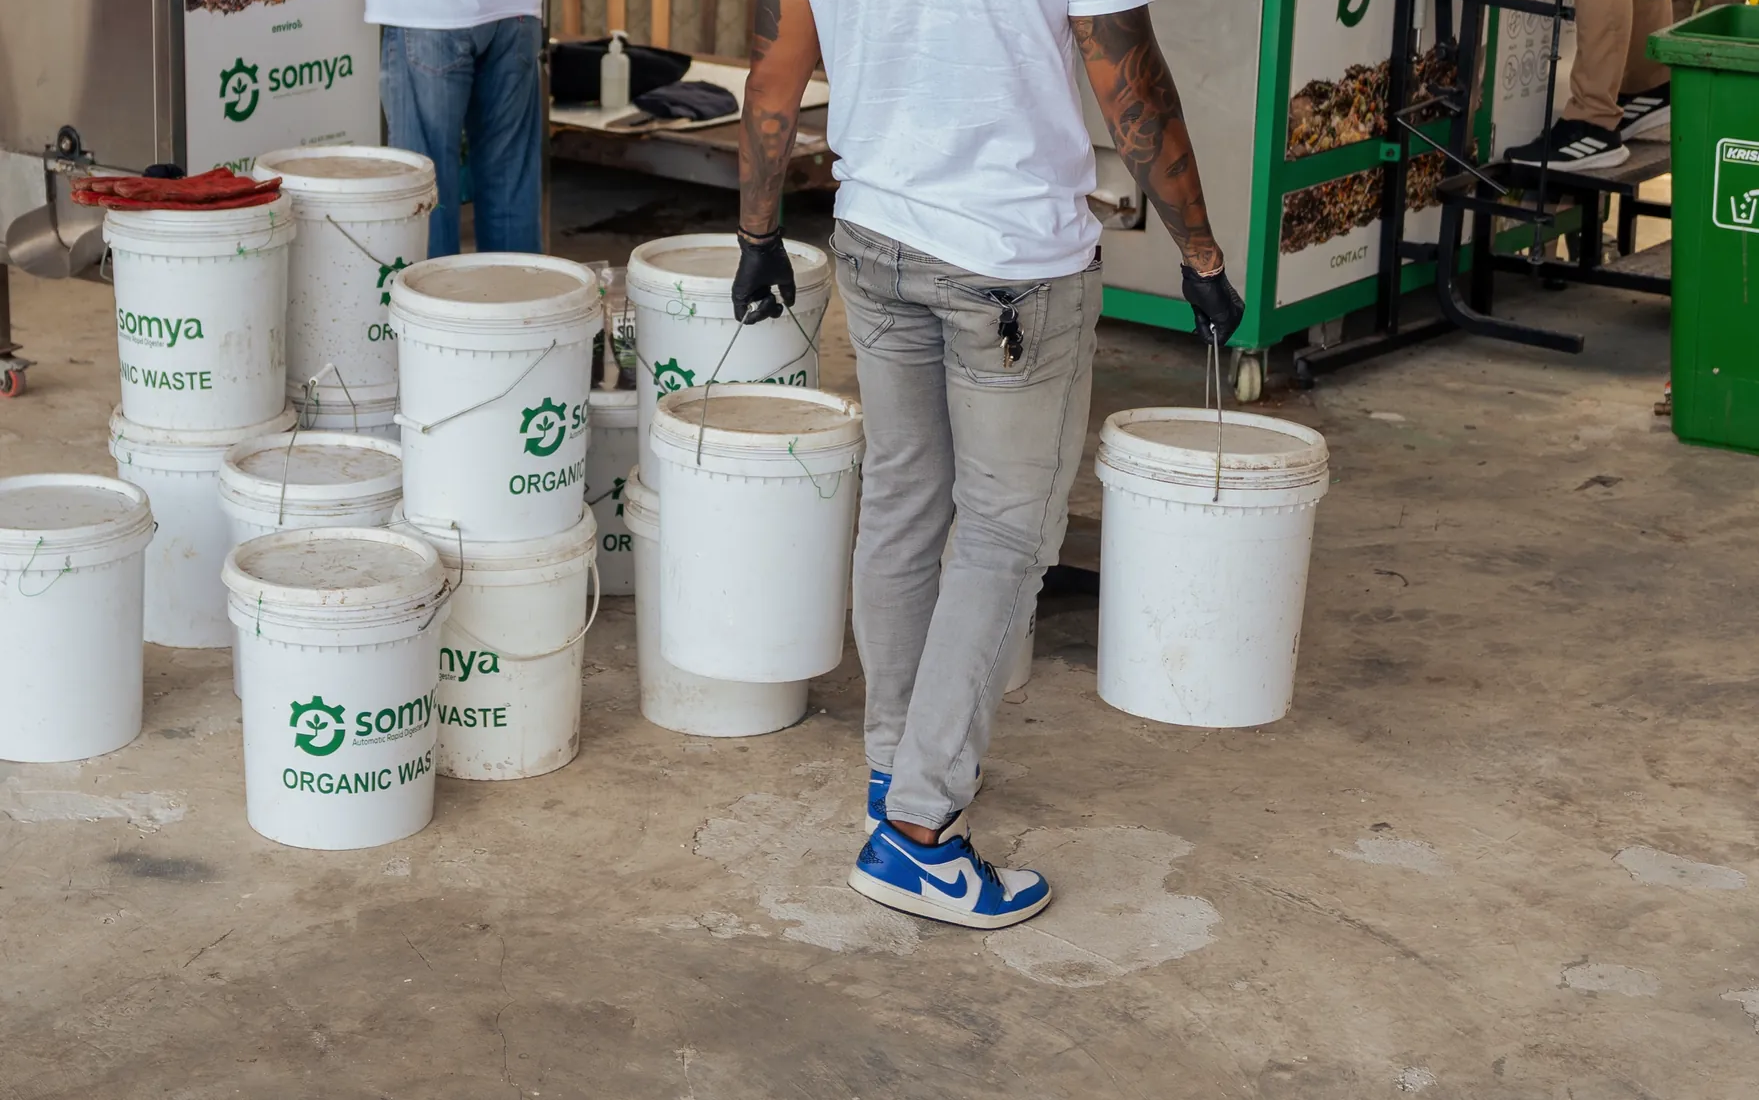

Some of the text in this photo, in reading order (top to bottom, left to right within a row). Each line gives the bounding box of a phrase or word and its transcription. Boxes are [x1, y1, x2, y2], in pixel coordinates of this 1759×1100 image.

[268, 53, 353, 91] somya
[1726, 147, 1759, 162] KRIS
[1330, 245, 1368, 268] CONTACT
[119, 307, 204, 348] somya
[142, 367, 212, 390] WASTE
[509, 458, 585, 495] ORGANIC
[352, 723, 423, 747] Automatic Rapid Digester
[283, 768, 392, 795] ORGANIC
